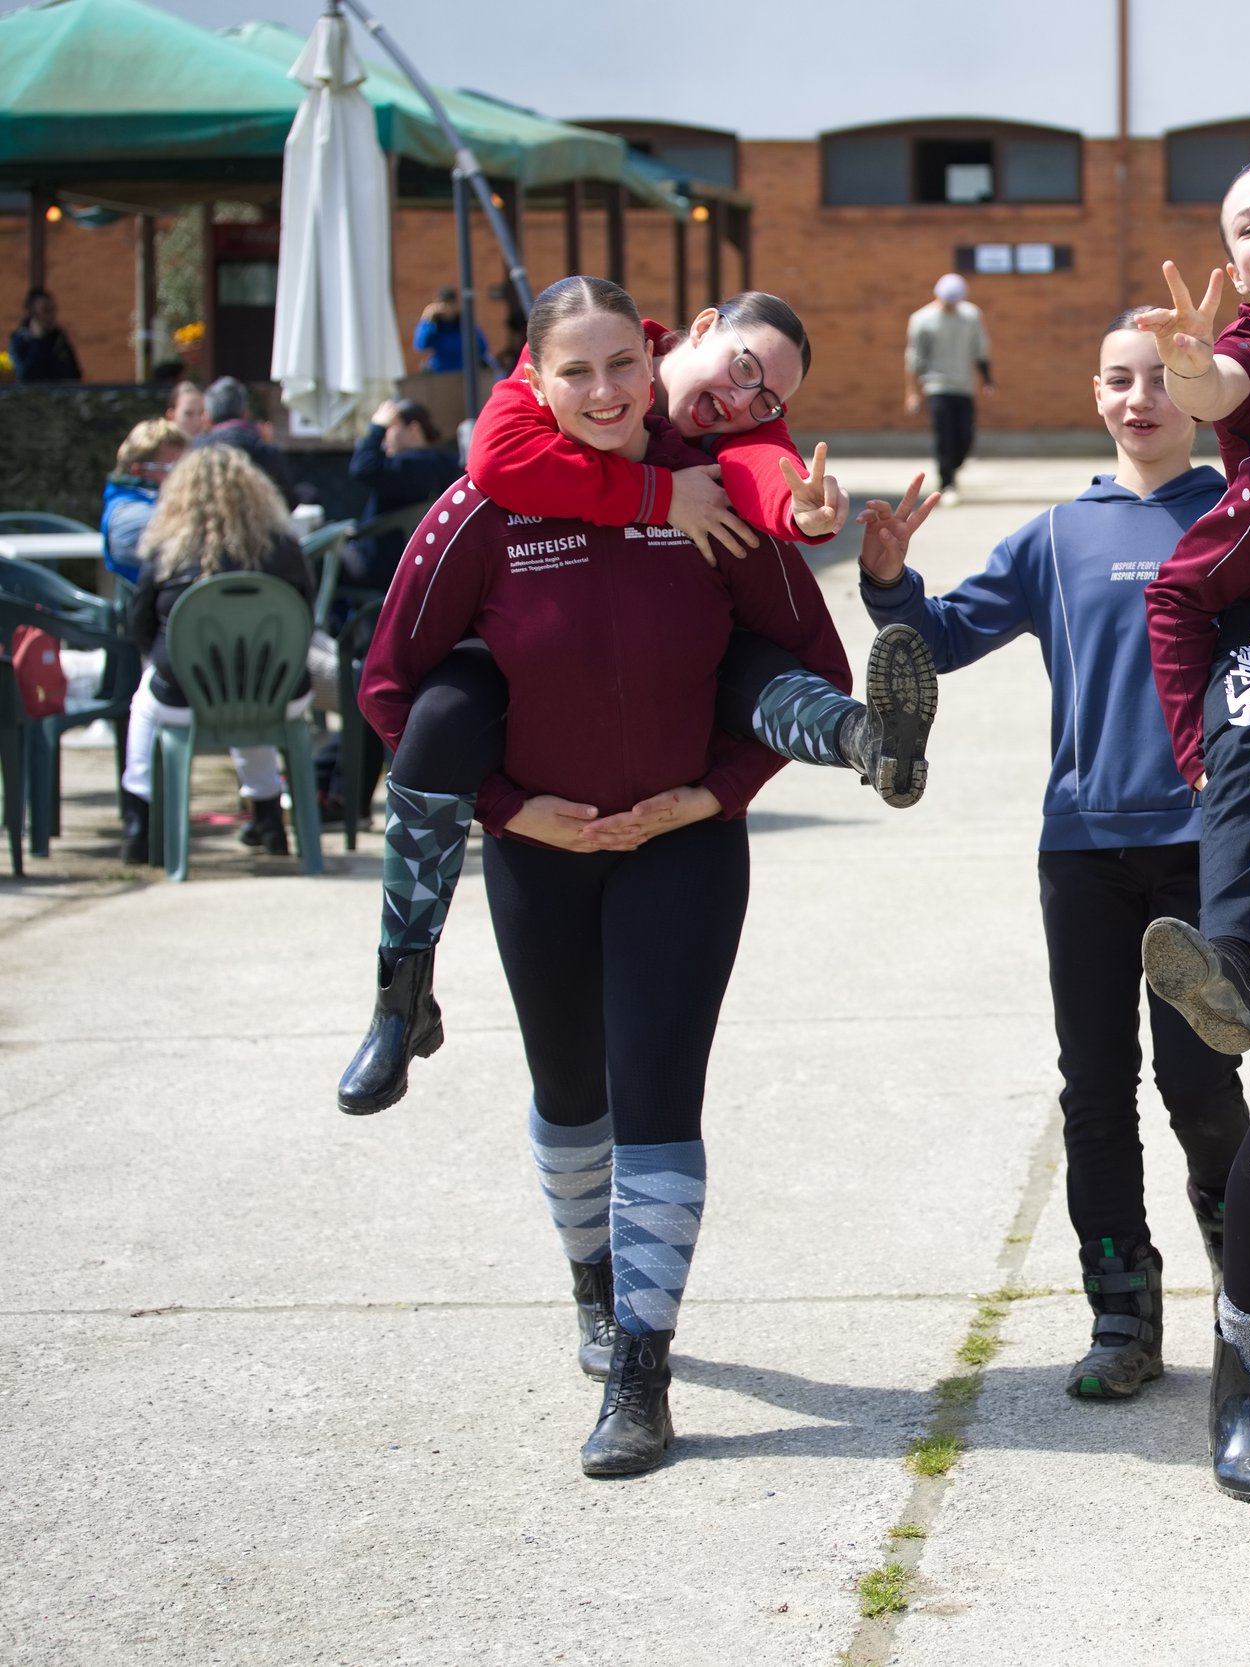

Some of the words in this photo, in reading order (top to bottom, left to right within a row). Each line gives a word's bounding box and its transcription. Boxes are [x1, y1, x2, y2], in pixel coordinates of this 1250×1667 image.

[507, 534, 587, 559] RAIFFEISEN
[528, 563, 559, 571] Toggenburg
[565, 556, 589, 566] Neckertal
[1111, 561, 1137, 571] INSPIRE
[1137, 561, 1161, 570] PEOPLE
[1110, 571, 1136, 581] INSPIRE
